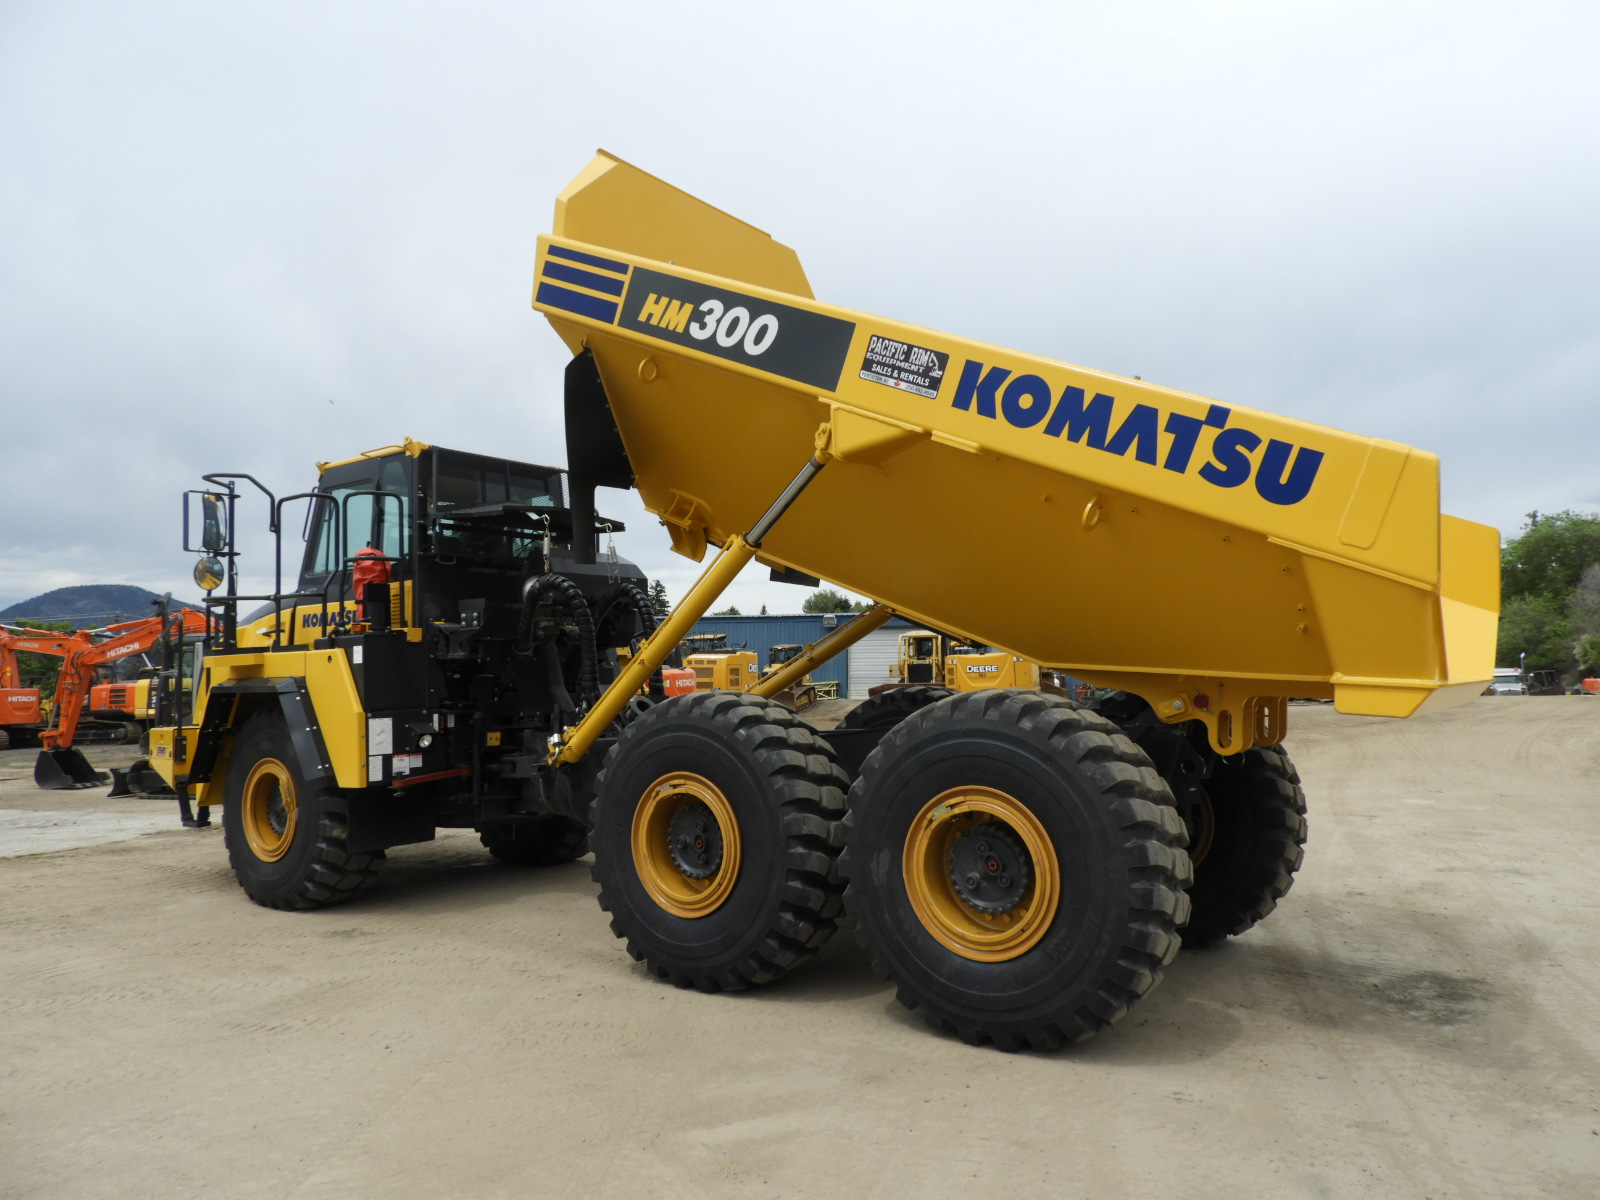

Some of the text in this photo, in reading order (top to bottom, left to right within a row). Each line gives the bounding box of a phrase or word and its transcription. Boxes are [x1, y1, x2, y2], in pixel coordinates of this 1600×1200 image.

[868, 336, 930, 366] PACIFIC RIM
[866, 352, 926, 373] EQUIPMENT
[872, 364, 930, 386] SALES & RENTALS
[951, 359, 1325, 506] KOMATSU
[107, 642, 140, 658] HITACHI
[676, 679, 695, 687] HITACHI
